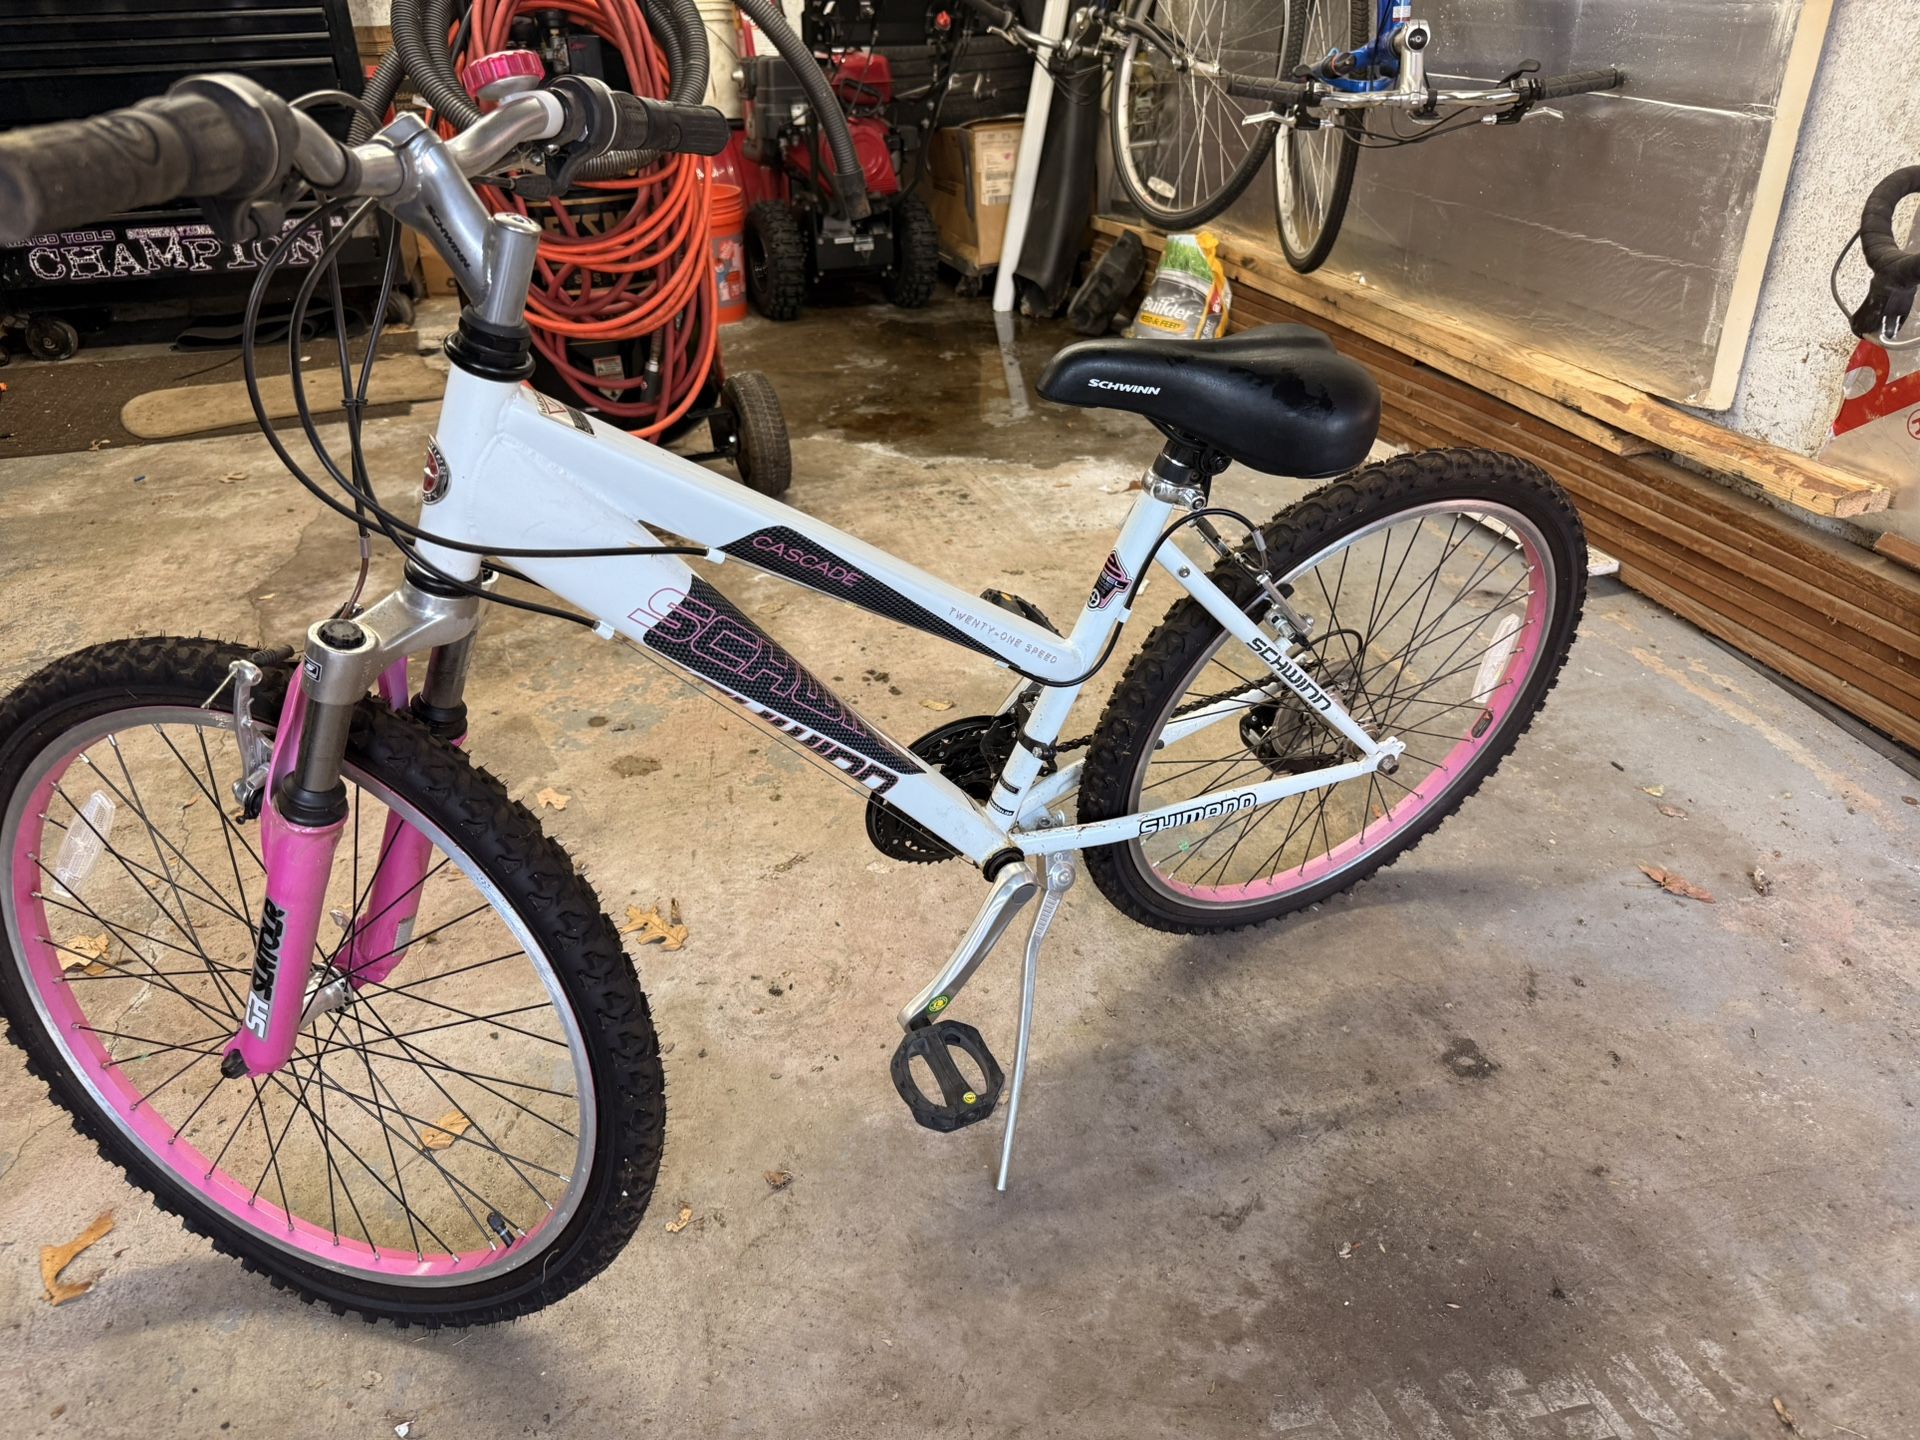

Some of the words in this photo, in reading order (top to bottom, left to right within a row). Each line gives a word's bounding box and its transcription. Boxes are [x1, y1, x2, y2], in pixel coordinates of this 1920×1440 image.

[29, 229, 324, 279] CHAMPION
[61, 230, 116, 243] TOOLS
[426, 204, 471, 271] SCHWINN
[1088, 379, 1161, 396] SCHWINN
[752, 536, 864, 588] CASCADE
[948, 606, 1023, 648] TWENTY-ONE
[1024, 643, 1059, 665] SPEED
[628, 588, 880, 743] SCHWI
[1246, 637, 1331, 711] SCHWINN
[1139, 792, 1257, 836] SHIMANO
